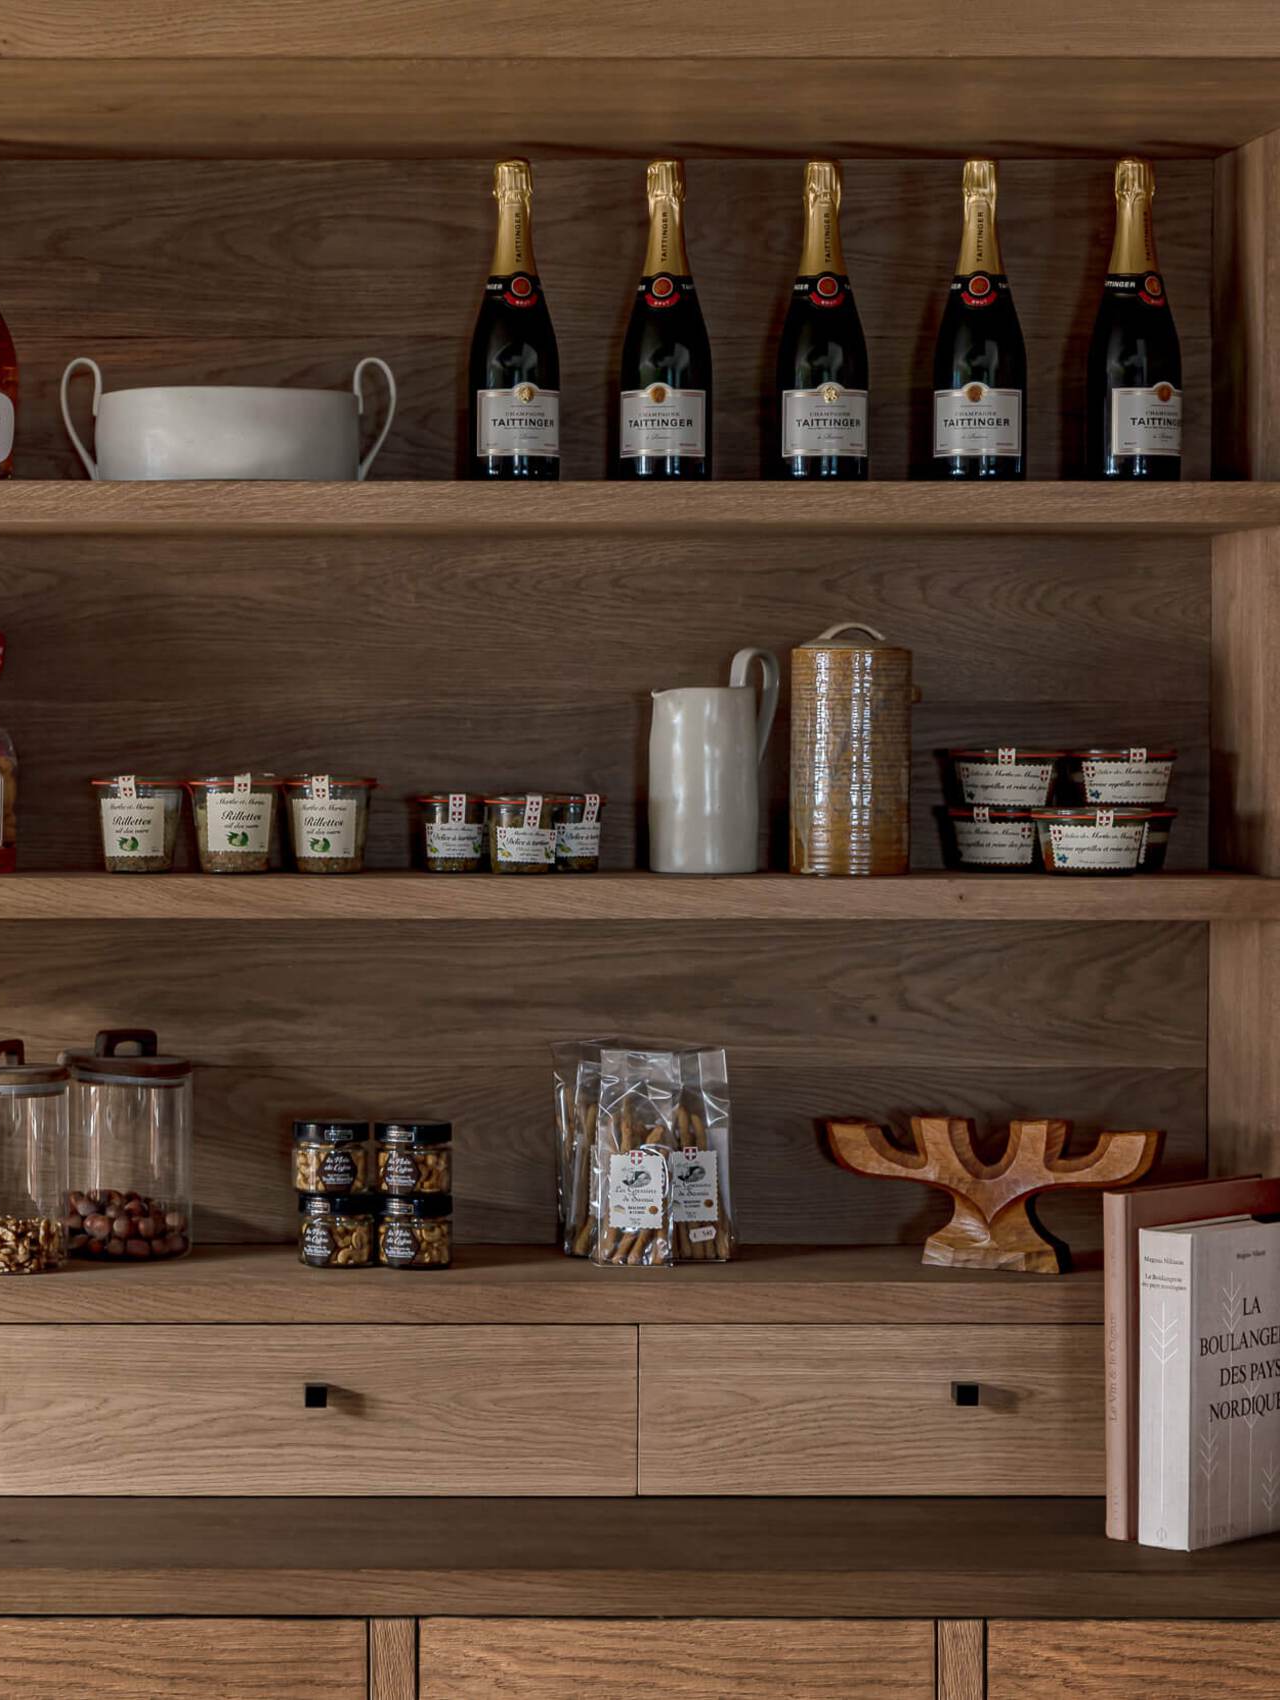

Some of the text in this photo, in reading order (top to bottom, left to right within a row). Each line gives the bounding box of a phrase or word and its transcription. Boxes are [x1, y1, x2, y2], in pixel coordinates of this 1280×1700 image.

[491, 418, 554, 428] TAITTINGER
[628, 419, 693, 428] TAITTINGER
[796, 418, 861, 428] TAITTINGER
[943, 418, 1011, 428] TAITTINGER
[112, 815, 152, 826] Rillettes
[220, 810, 261, 821] Rillettes
[304, 816, 344, 827] Rillettes
[1243, 1296, 1262, 1316] LA
[1220, 1365, 1246, 1387] DES
